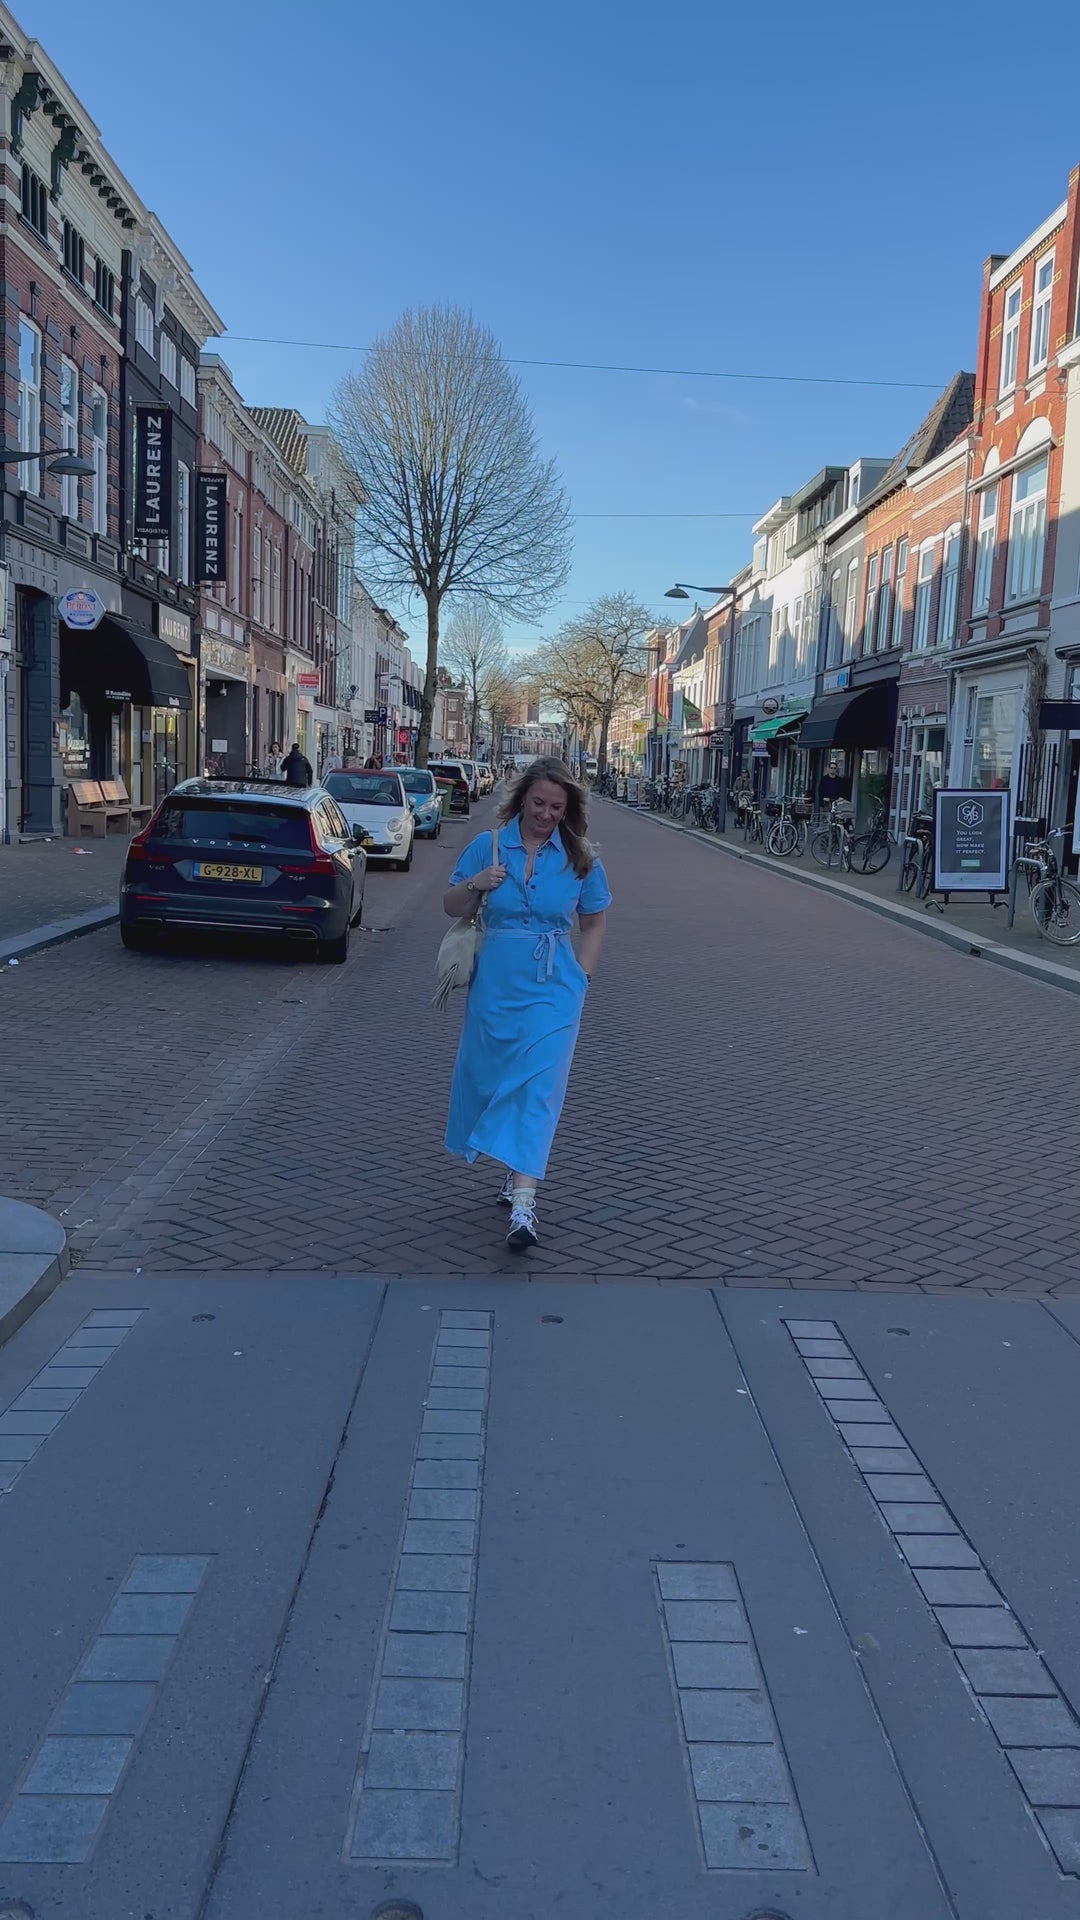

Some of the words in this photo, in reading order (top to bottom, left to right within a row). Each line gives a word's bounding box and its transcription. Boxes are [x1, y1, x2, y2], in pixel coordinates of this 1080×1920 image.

[145, 415, 162, 524] LAURENZ
[136, 527, 169, 535] VISAGISTEN
[205, 485, 218, 574] LAURENZ
[66, 601, 96, 611] PERONI
[161, 615, 189, 642] LAURENZ
[380, 707, 387, 717] P
[193, 838, 267, 849] VOLVO
[203, 864, 258, 880] G-928-XL
